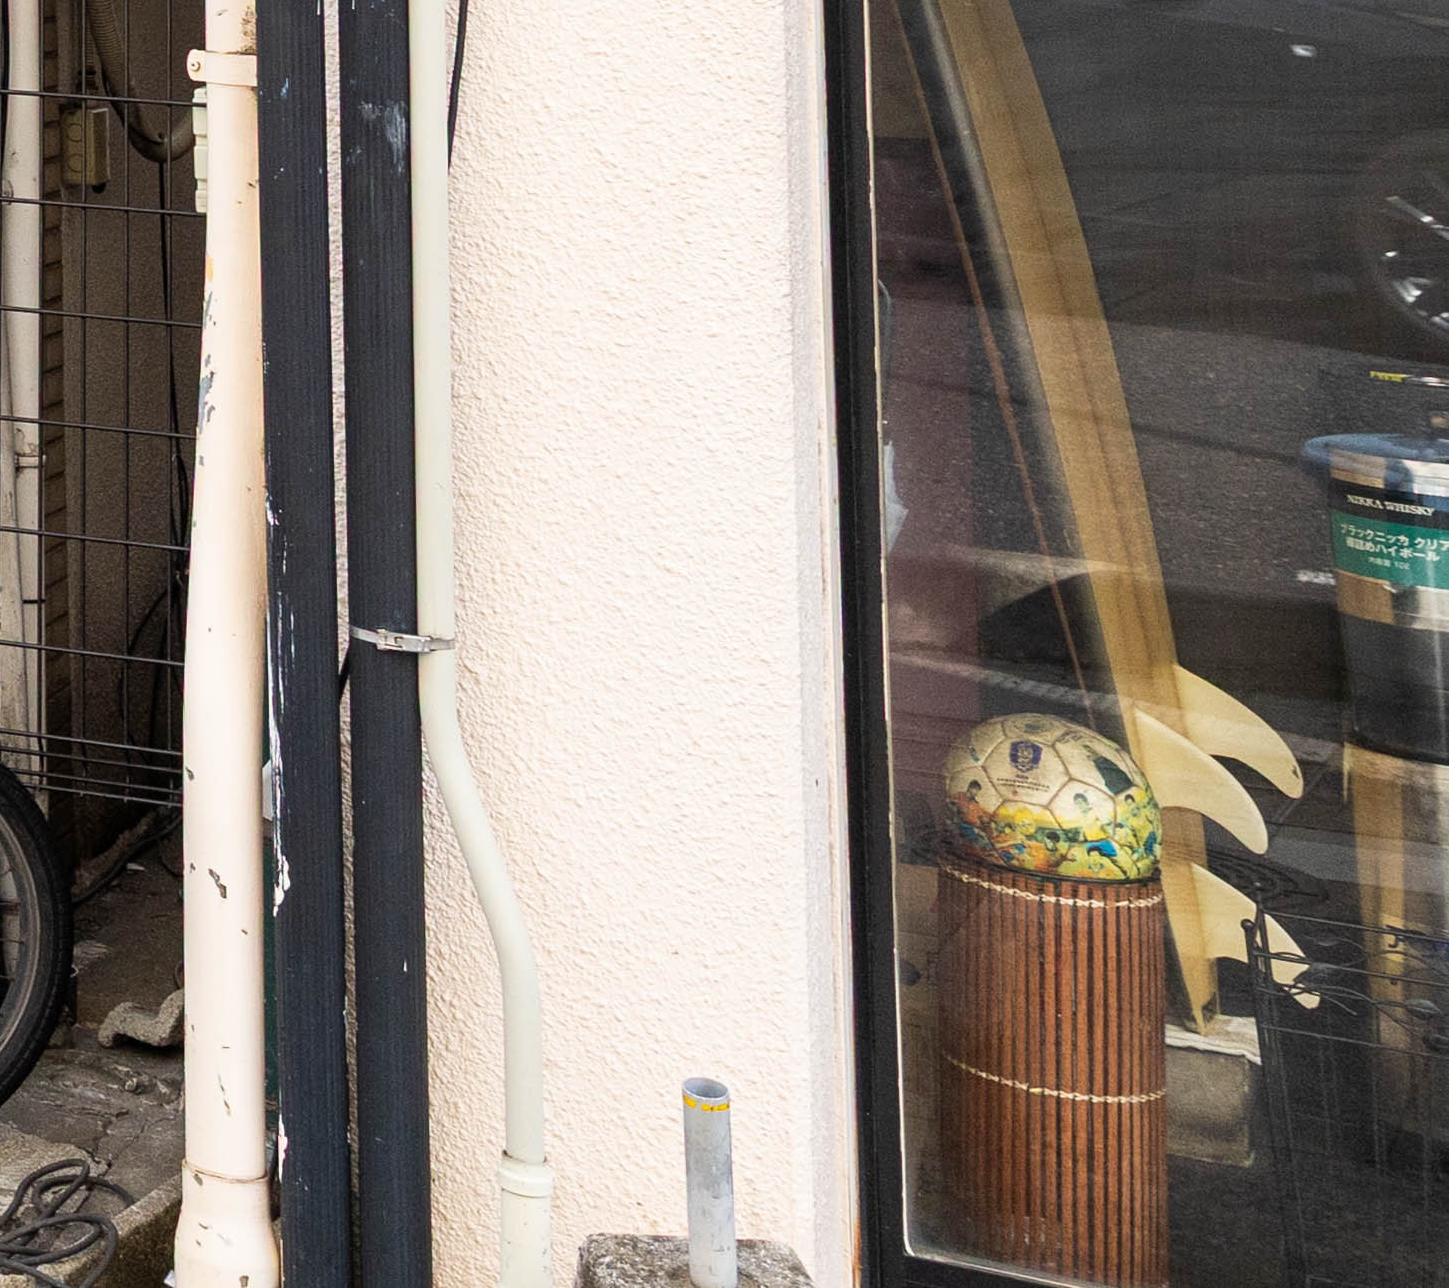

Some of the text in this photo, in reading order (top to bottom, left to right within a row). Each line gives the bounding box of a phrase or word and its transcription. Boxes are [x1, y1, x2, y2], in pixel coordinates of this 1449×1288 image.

[1346, 494, 1435, 517] NIKKA WHISKY
[1341, 523, 1409, 547] ブラックニッカ
